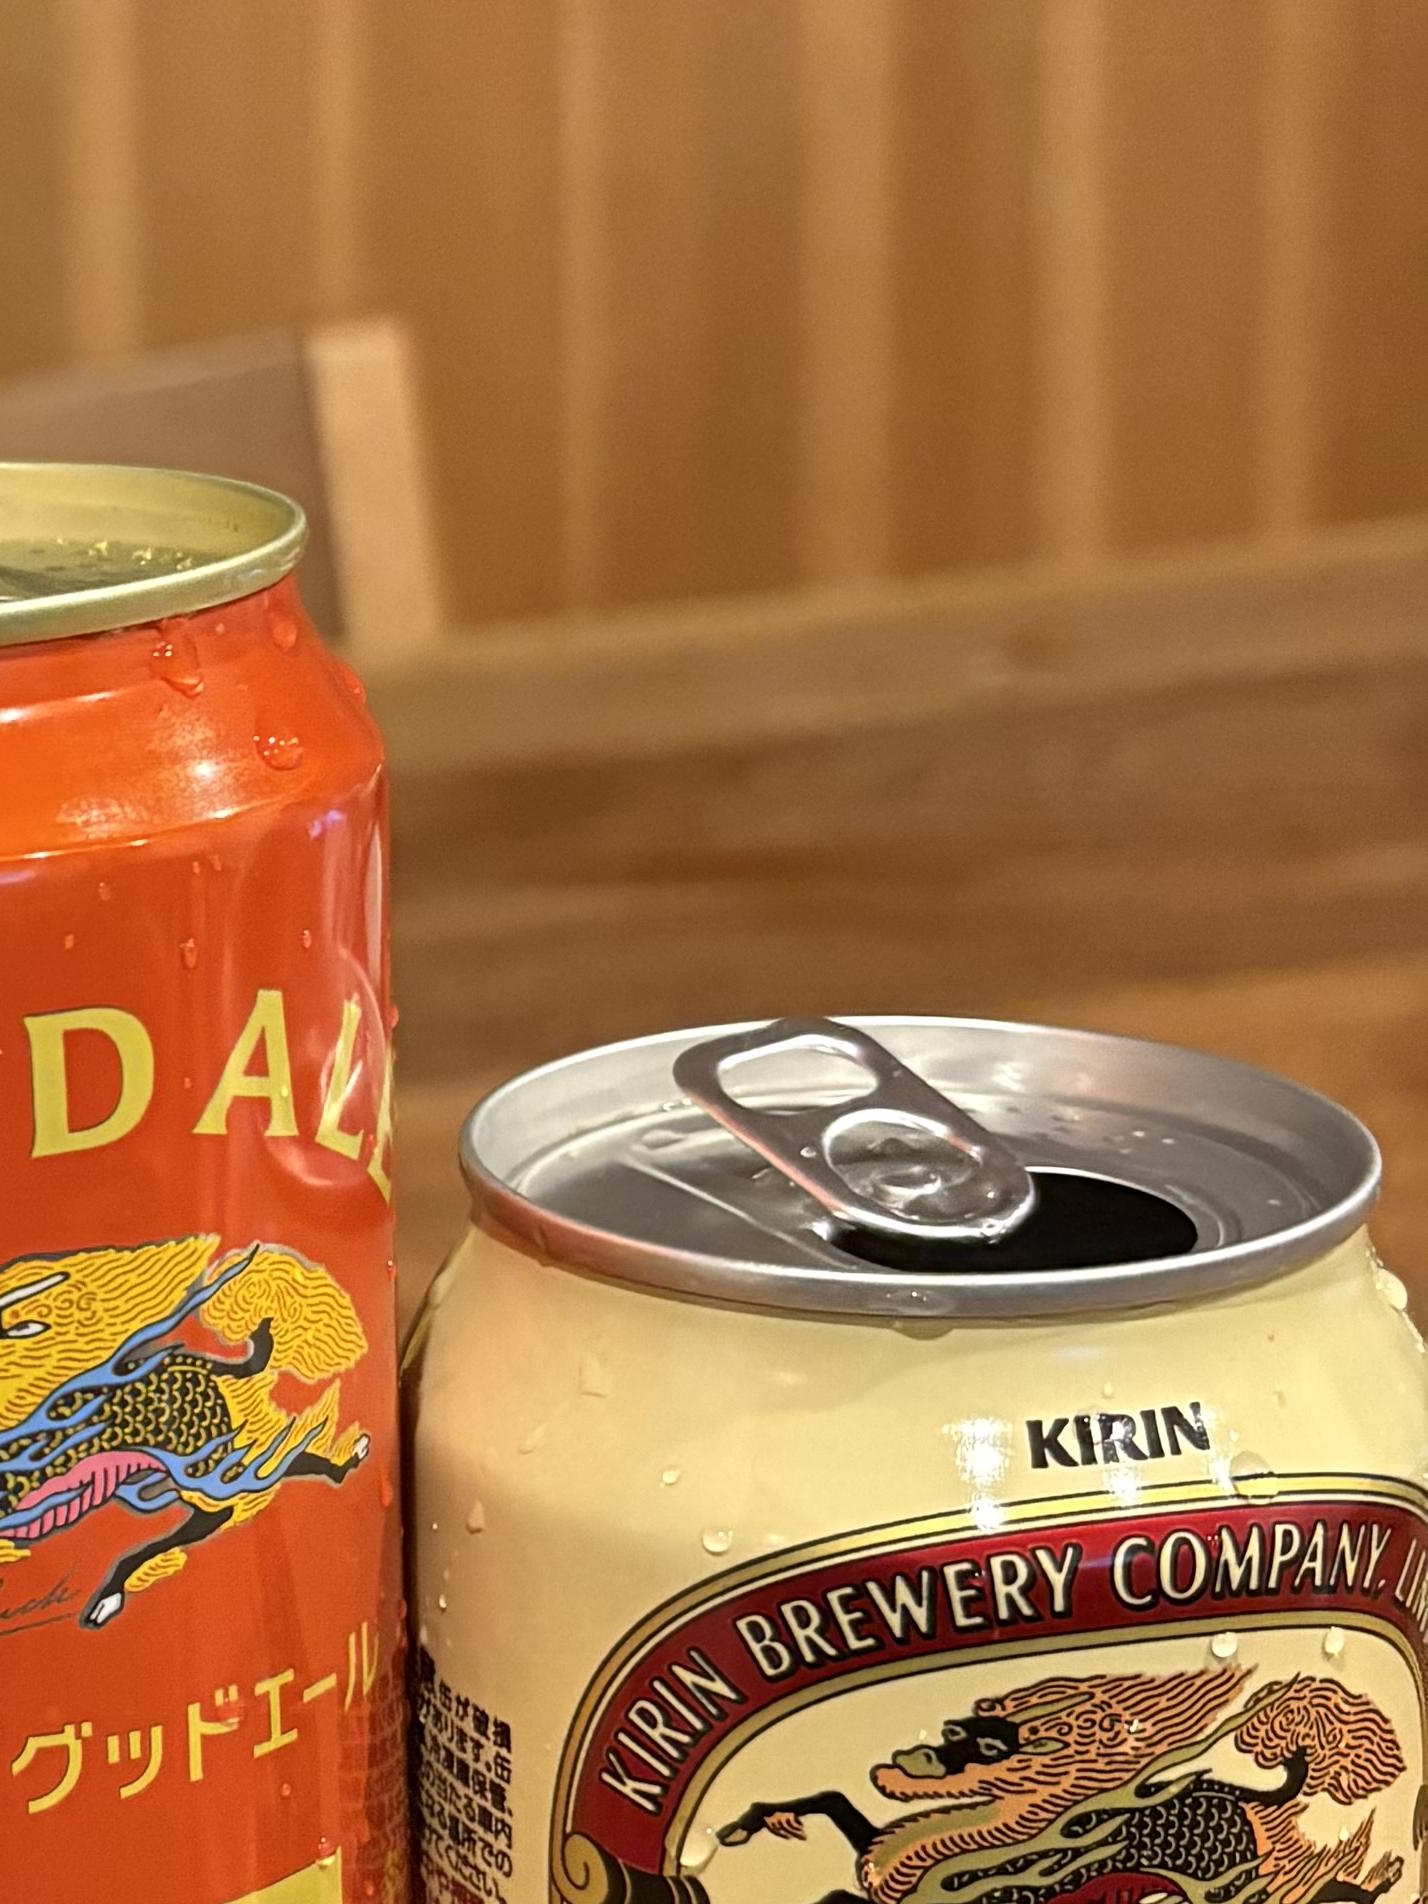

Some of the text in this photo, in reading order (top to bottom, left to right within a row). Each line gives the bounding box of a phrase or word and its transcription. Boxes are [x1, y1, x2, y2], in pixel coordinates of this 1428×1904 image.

[1026, 1400, 1211, 1470] KIRIN
[604, 1649, 742, 1816] KIRIN
[732, 1541, 1083, 1686] BREWERY
[1112, 1516, 1392, 1608] COMPANY,
